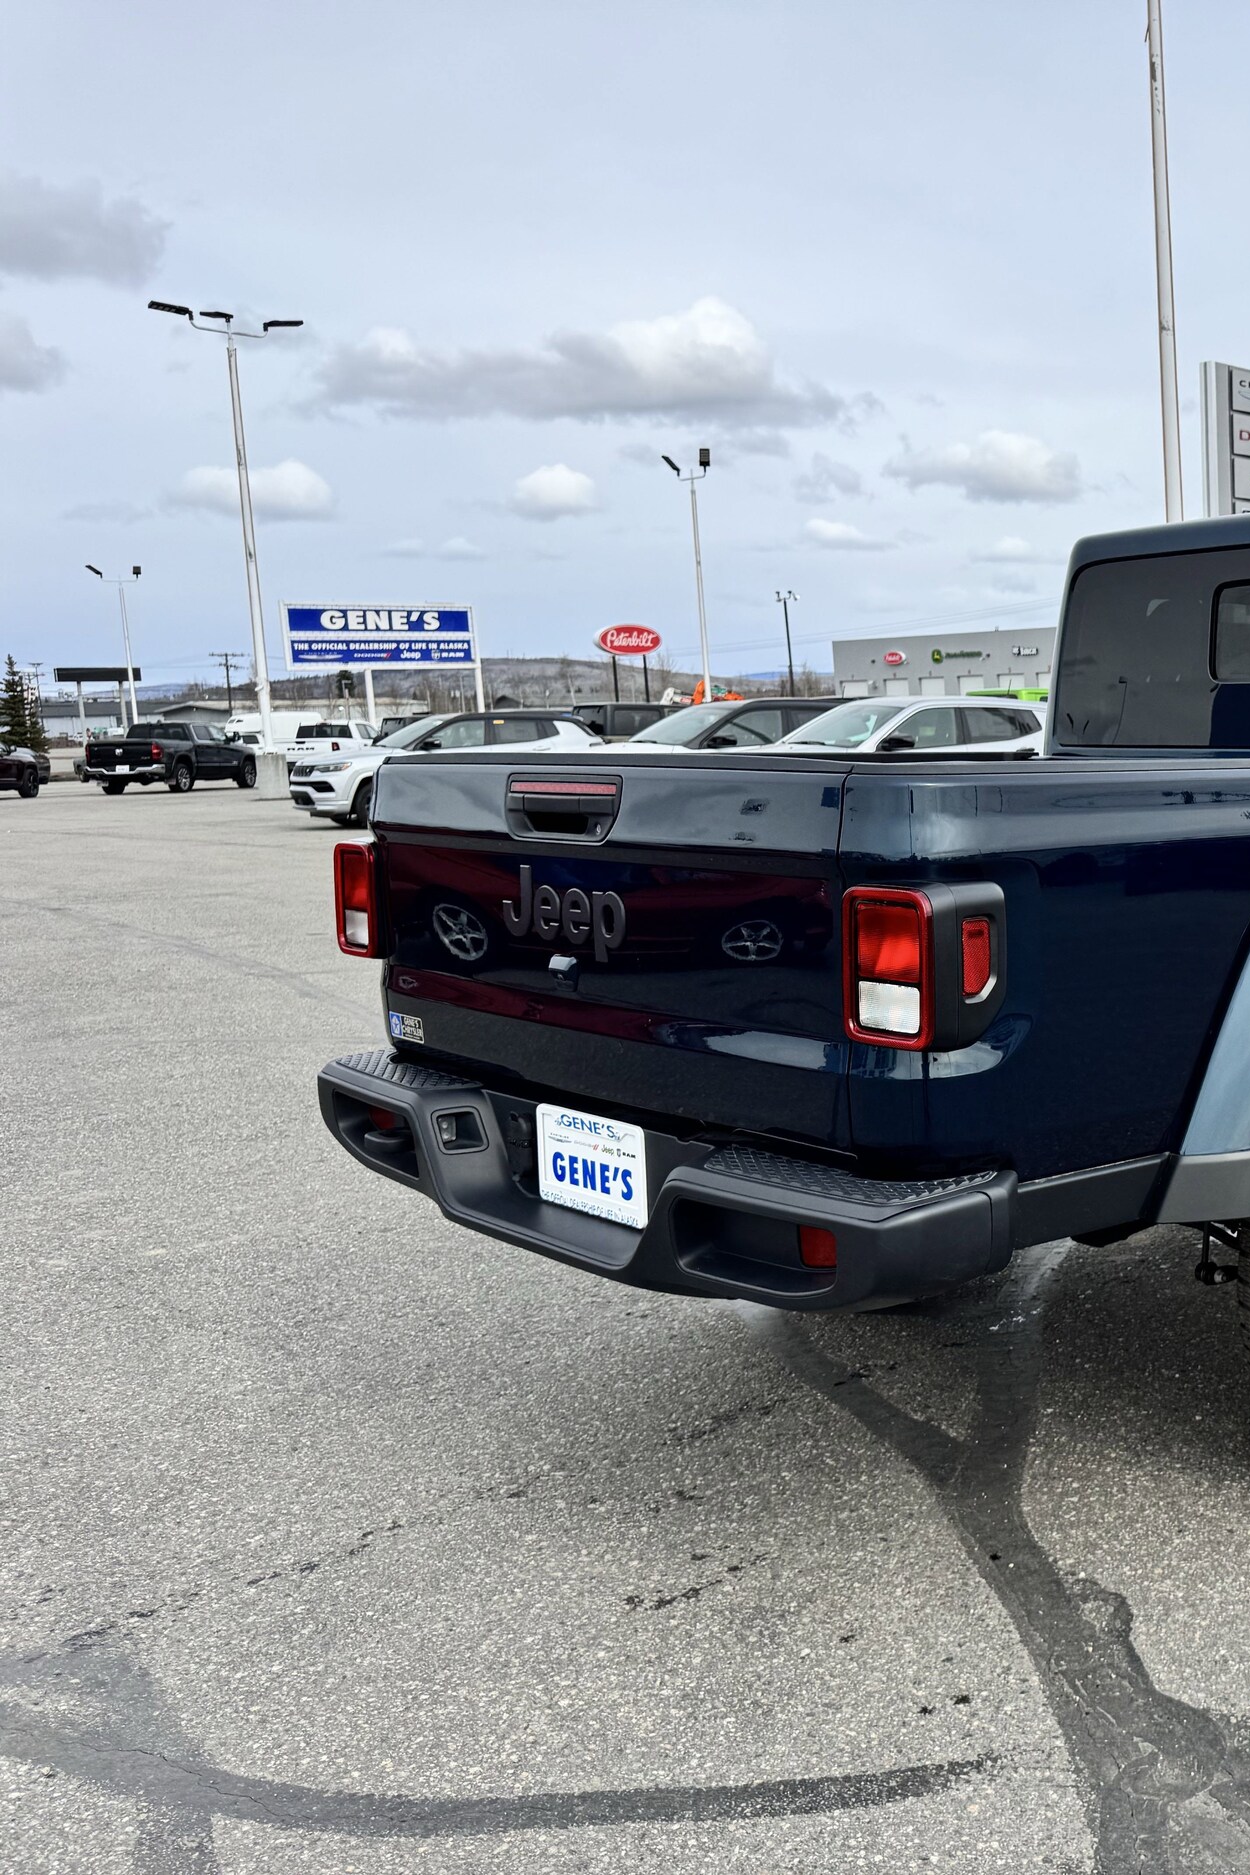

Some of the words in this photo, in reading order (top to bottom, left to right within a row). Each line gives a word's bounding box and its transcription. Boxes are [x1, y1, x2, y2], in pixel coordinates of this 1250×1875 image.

[320, 610, 441, 631] GENE'S
[293, 642, 309, 650] THE
[311, 642, 347, 650] OFFICIAL
[349, 642, 397, 650] DEALERSHIP
[399, 642, 410, 650] OF
[411, 642, 427, 650] LIFE
[428, 642, 438, 650] IN
[440, 642, 469, 650] ALASKA
[606, 629, 658, 648] Peterbilt
[400, 650, 421, 660] Jeep
[502, 864, 626, 963] Jeep
[560, 1114, 616, 1138] GENE'S
[552, 1151, 633, 1201] GENE'S
